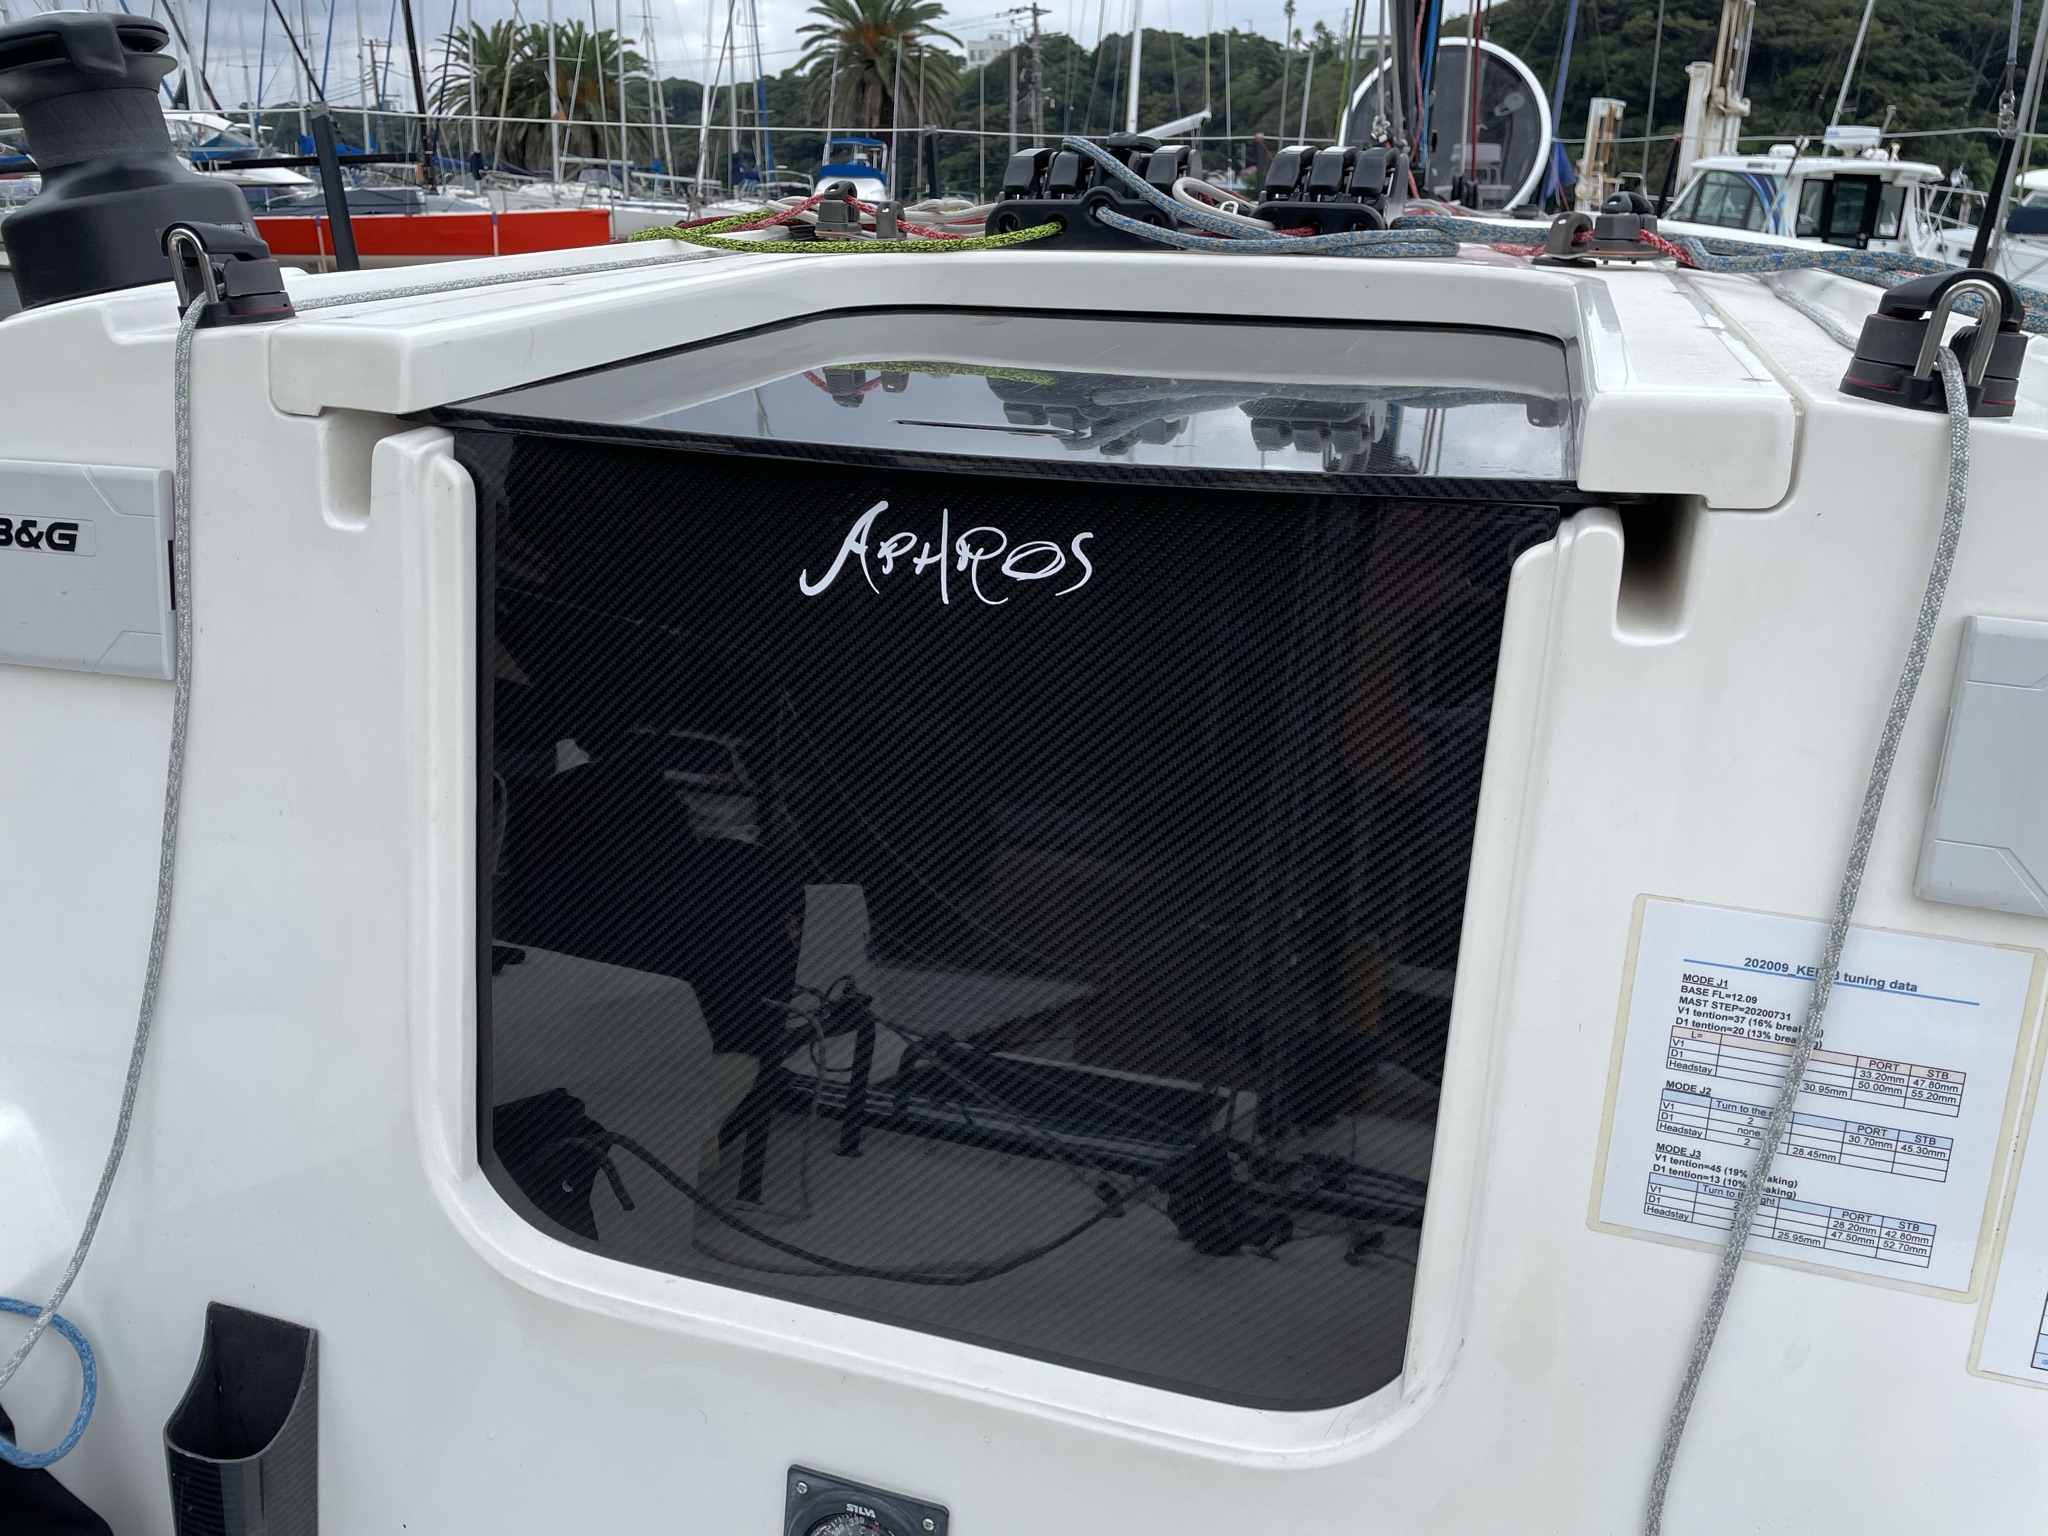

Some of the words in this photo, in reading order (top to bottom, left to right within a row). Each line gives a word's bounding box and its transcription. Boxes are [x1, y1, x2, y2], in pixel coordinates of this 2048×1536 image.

[0, 517, 79, 552] B&G
[1680, 985, 1710, 997] BASE
[1711, 989, 1758, 1004] FL=12.09
[1682, 973, 1715, 985] MODE
[1716, 979, 1728, 988] J1
[1843, 972, 1886, 990] tuning
[1889, 979, 1918, 993] data
[1677, 1006, 1690, 1015] V1
[1693, 1008, 1746, 1024] tention=37
[1748, 1017, 1773, 1029] (16%
[1679, 996, 1709, 1008] MAST
[1711, 1001, 1791, 1021] STEP=20200731
[1675, 1017, 1689, 1026] D1
[1691, 1019, 1745, 1035] tention=20
[1747, 1028, 1772, 1040] (13%
[1672, 1038, 1685, 1047] V1
[1859, 1070, 1905, 1085] 33.20mm
[1912, 1079, 1959, 1093] 47.80mm
[1690, 1030, 1703, 1039] L=
[1869, 1059, 1900, 1072] PORT
[1926, 1069, 1949, 1080] STB
[1665, 1080, 1697, 1093] MODE
[1699, 1086, 1712, 1095] J2
[1668, 1059, 1713, 1075] Headstay
[1803, 1082, 1848, 1097] 30.95mm
[1670, 1049, 1684, 1058] D1
[1857, 1081, 1903, 1095] 50.00mm
[1911, 1089, 1957, 1104] 55.20mm
[1660, 1112, 1674, 1121] D1
[1737, 1127, 1761, 1137] none
[1662, 1101, 1675, 1110] V1
[1747, 1117, 1754, 1125] 2
[1848, 1135, 1893, 1149] 30.70mm
[1900, 1144, 1946, 1158] 45.30mm
[1716, 1100, 1737, 1111] Turn
[1740, 1105, 1749, 1113] to
[1751, 1107, 1766, 1116] the
[1857, 1125, 1888, 1137] PORT
[1914, 1134, 1937, 1145] STB
[1656, 1142, 1687, 1155] MODE
[1689, 1149, 1701, 1158] J3
[1659, 1122, 1703, 1138] Headstay
[1743, 1138, 1750, 1146] 2
[1792, 1147, 1837, 1162] 28.45mm
[1652, 1164, 1665, 1173] D1
[1668, 1167, 1721, 1184] tention=13
[1723, 1177, 1747, 1189] (10%
[1654, 1153, 1667, 1162] V1
[1669, 1156, 1722, 1173] tention=45
[1724, 1166, 1748, 1178] (19%
[1650, 1185, 1662, 1194] V1
[1733, 1202, 1740, 1210] 2
[1833, 1221, 1877, 1235] 28.20mm
[1884, 1230, 1930, 1245] 42.80mm
[1702, 1185, 1724, 1195] Turn
[1841, 1211, 1873, 1223] PORT
[1898, 1221, 1920, 1232] STB
[1646, 1206, 1690, 1221] Headstay
[1777, 1231, 1821, 1247] 25.95mm
[1648, 1195, 1661, 1204] D1
[1830, 1231, 1875, 1246] 47.50mm
[1883, 1240, 1928, 1255] 52.70mm
[846, 1503, 877, 1519] SILVA
